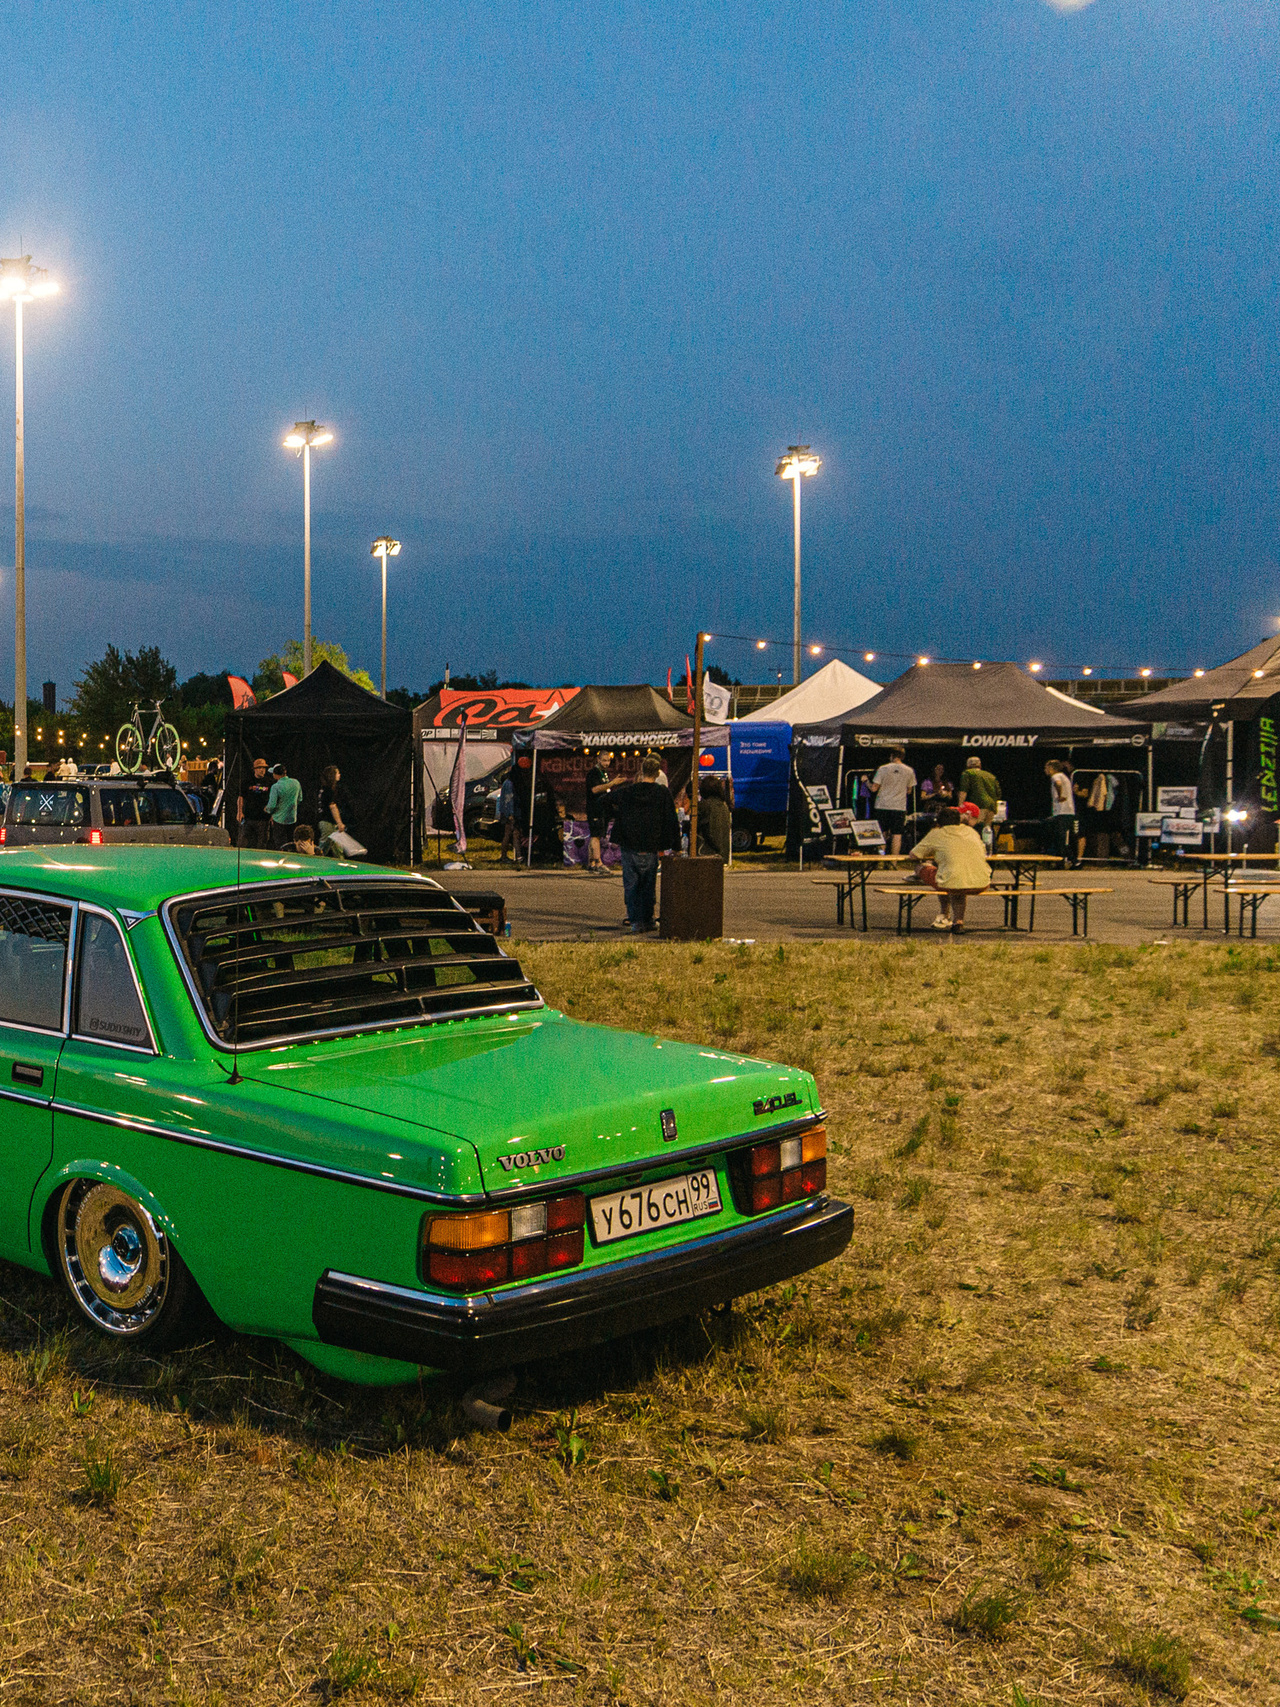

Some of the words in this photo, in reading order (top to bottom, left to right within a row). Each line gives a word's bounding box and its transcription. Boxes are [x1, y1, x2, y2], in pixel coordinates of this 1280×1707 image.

[962, 735, 1039, 747] LOWDAILY
[497, 1145, 565, 1172] VOLVO
[690, 1173, 710, 1201] 99
[693, 1201, 709, 1212] RUS
